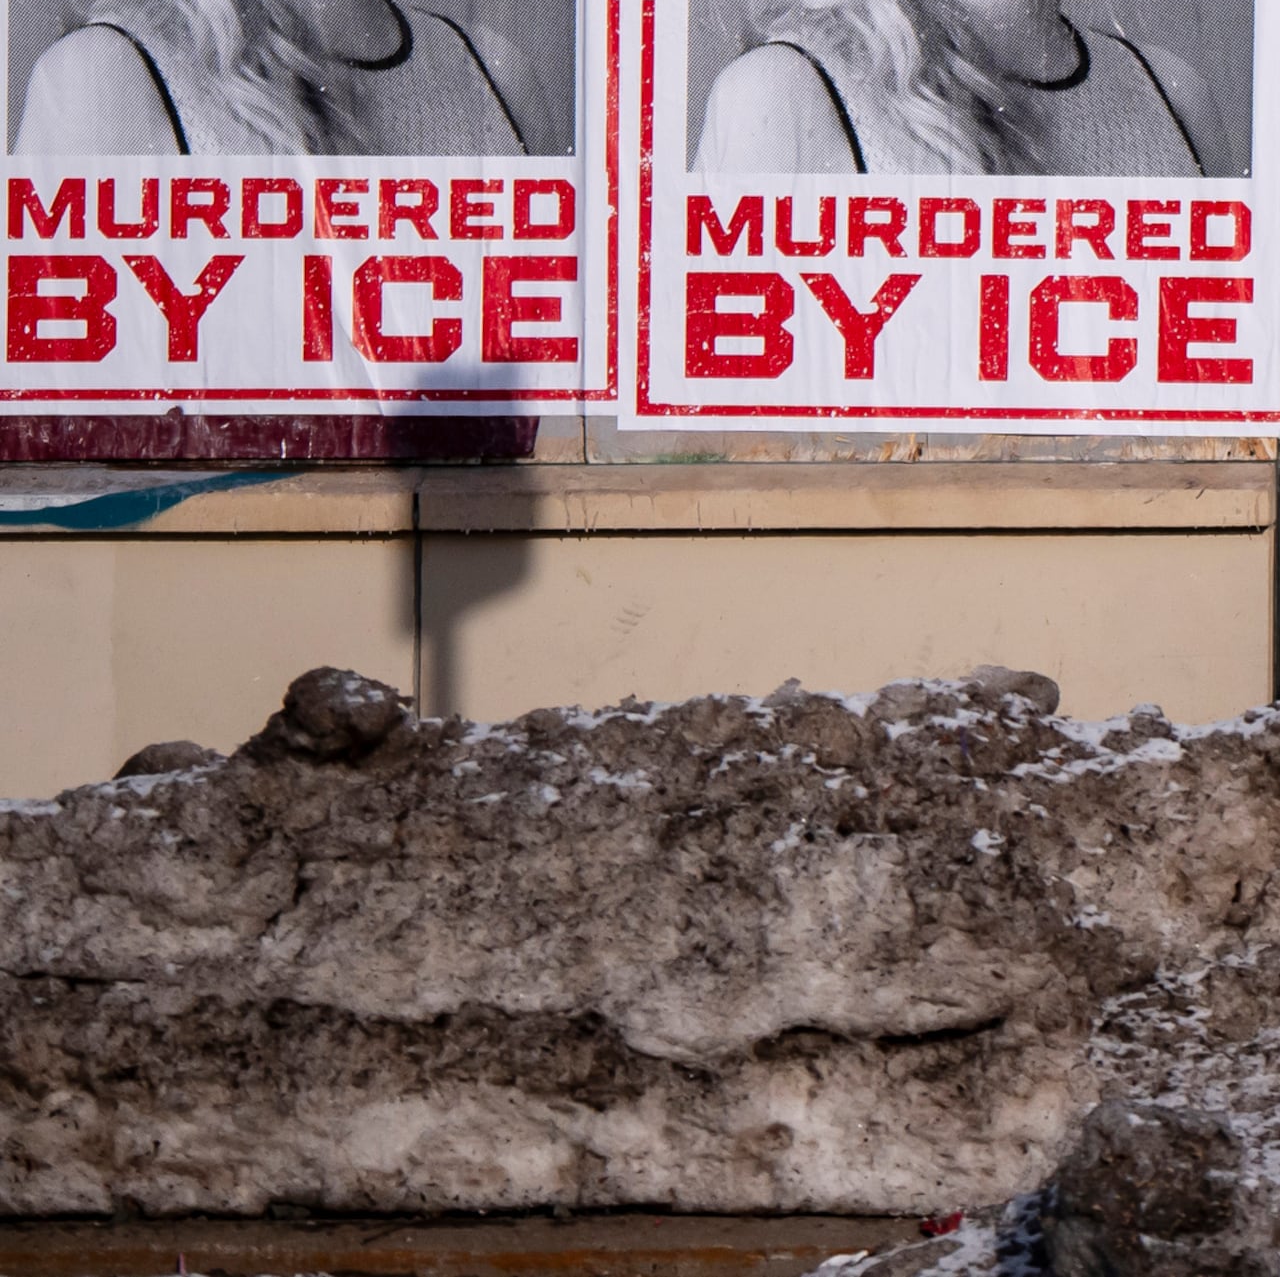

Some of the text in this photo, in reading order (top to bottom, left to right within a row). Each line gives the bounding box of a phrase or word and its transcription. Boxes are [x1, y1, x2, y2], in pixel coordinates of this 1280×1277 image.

[8, 178, 575, 240] MURDERED
[687, 196, 1251, 261] MURDERED
[7, 255, 578, 363] BY ICE
[685, 272, 1253, 383] BY ICE
